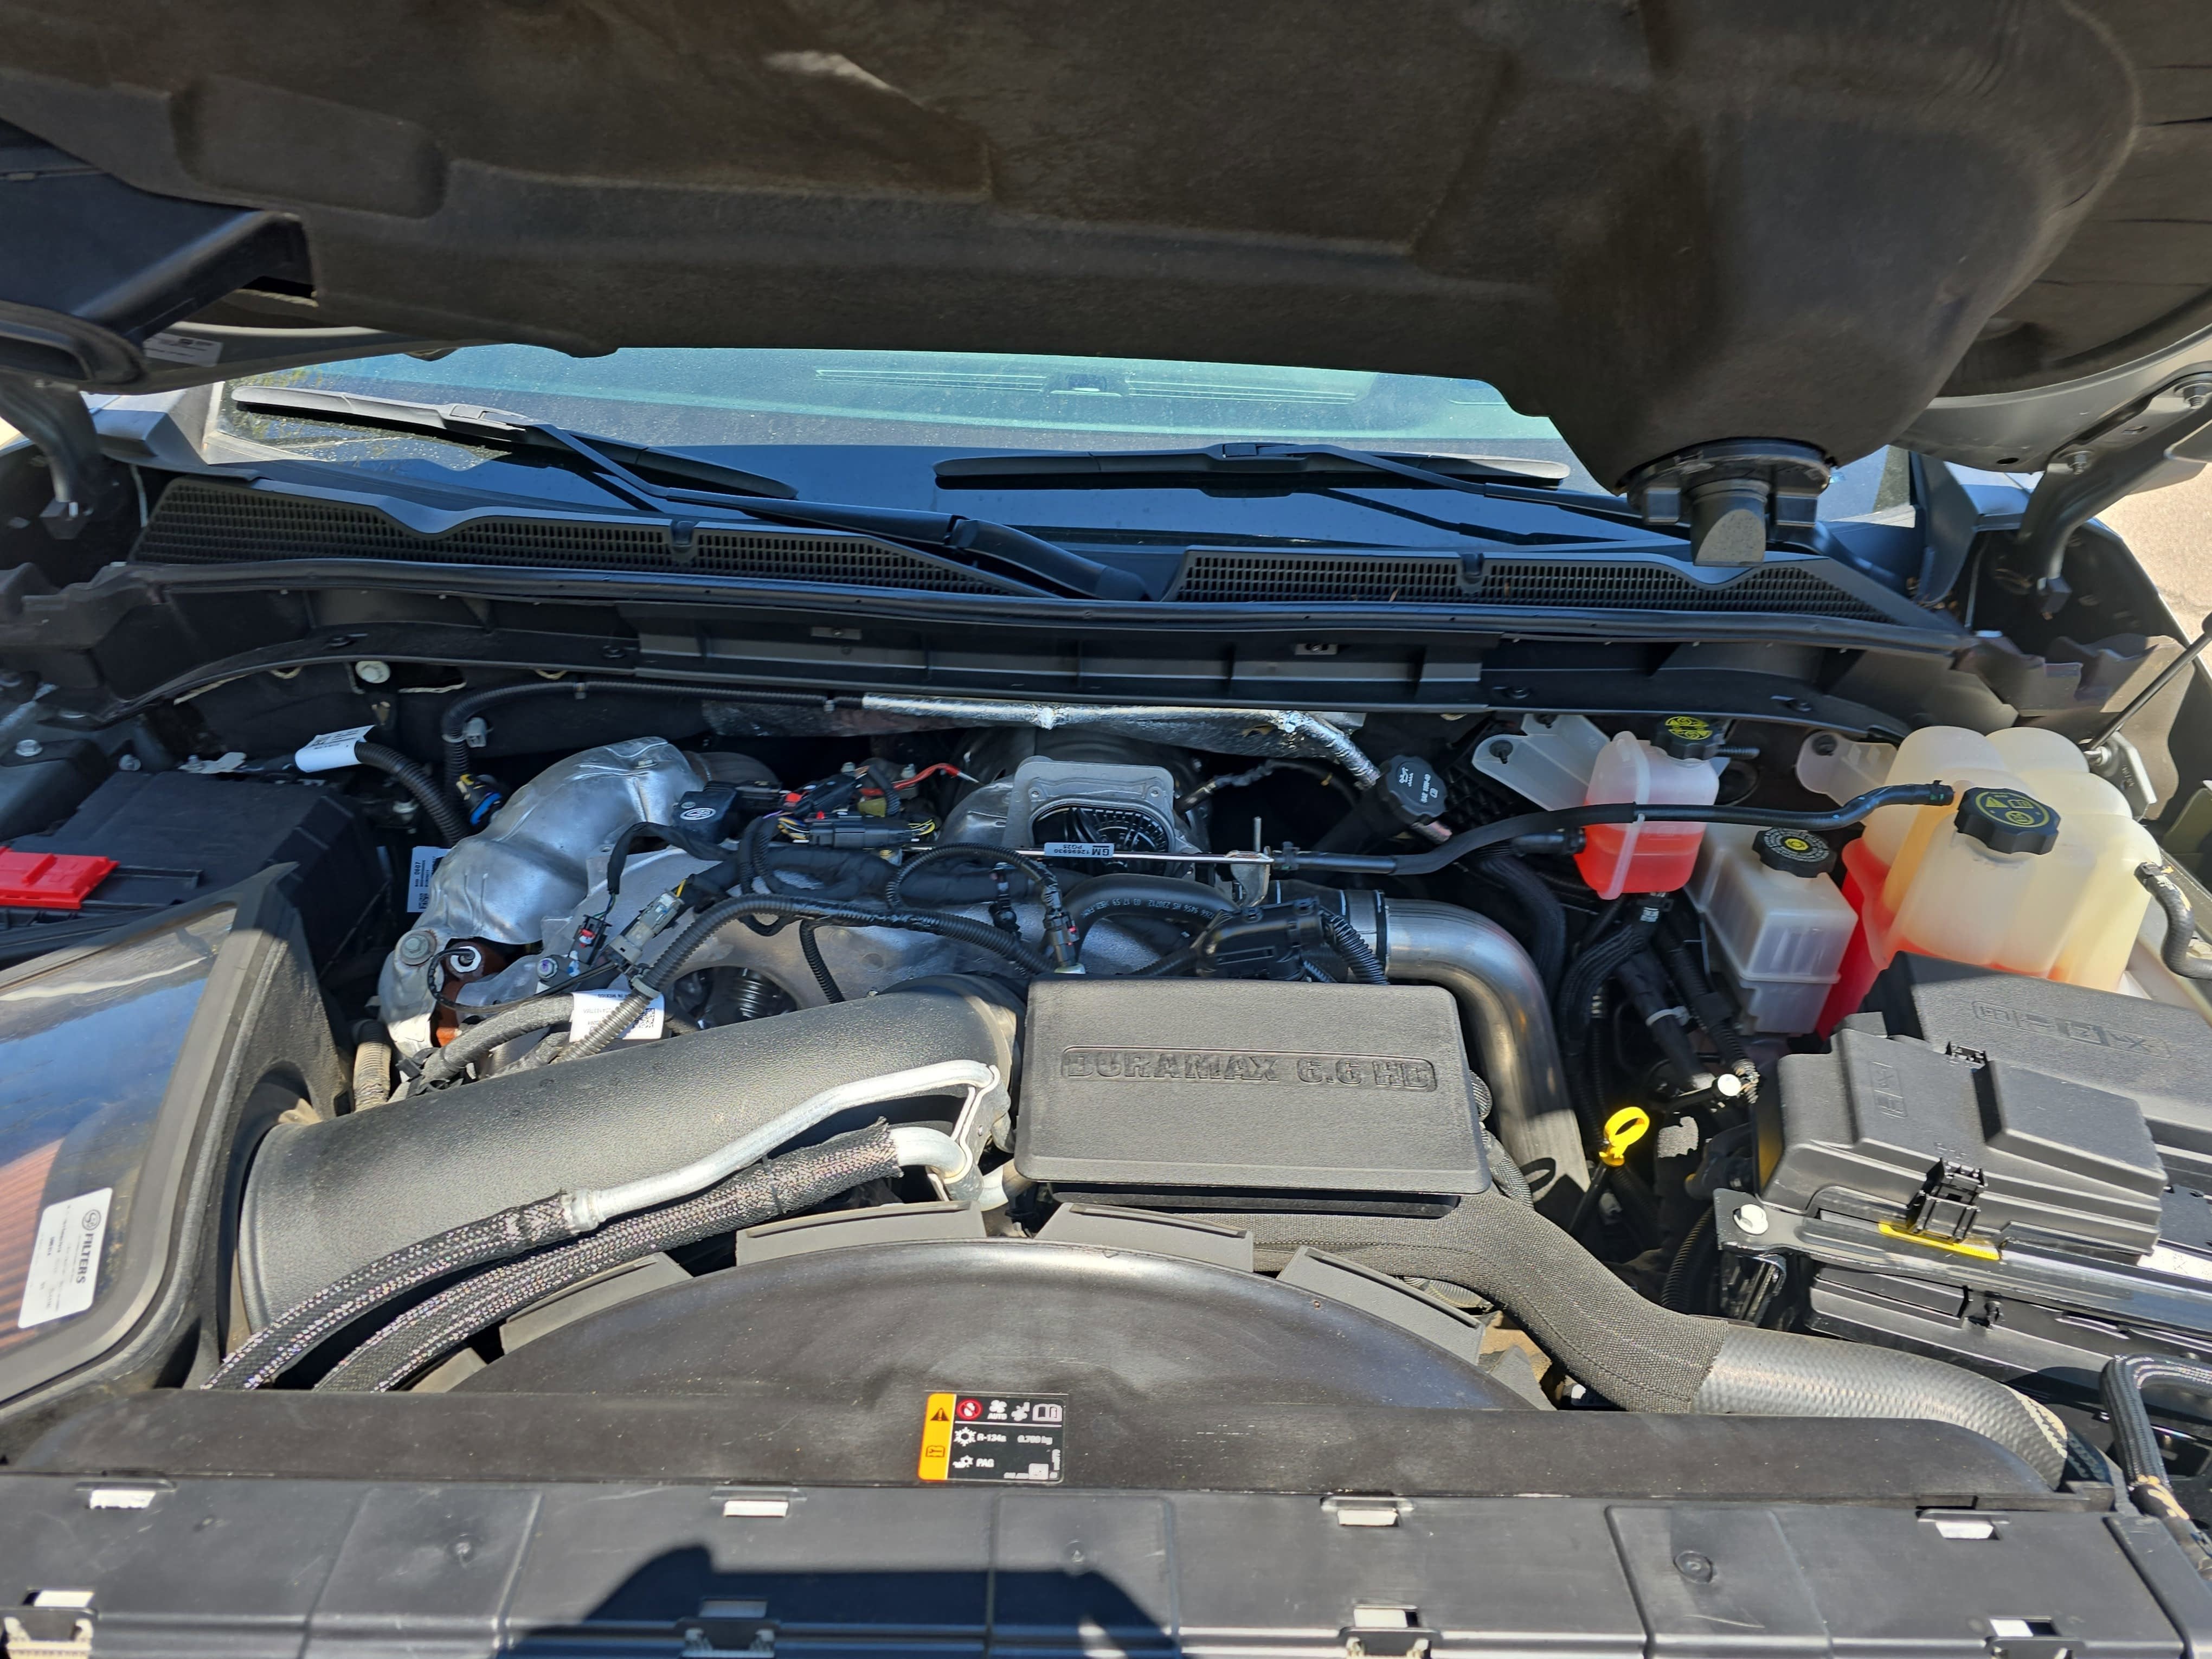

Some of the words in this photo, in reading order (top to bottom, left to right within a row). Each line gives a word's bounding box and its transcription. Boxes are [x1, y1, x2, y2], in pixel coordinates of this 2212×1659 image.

[1091, 848, 1110, 856] GM
[1068, 1053, 1279, 1082] DURAMAX
[1296, 1059, 1362, 1085] 6.6
[1374, 1062, 1431, 1088] HD
[75, 1233, 94, 1284] FILTERS
[976, 1433, 1007, 1443] R-134a
[976, 1458, 995, 1468] PAG
